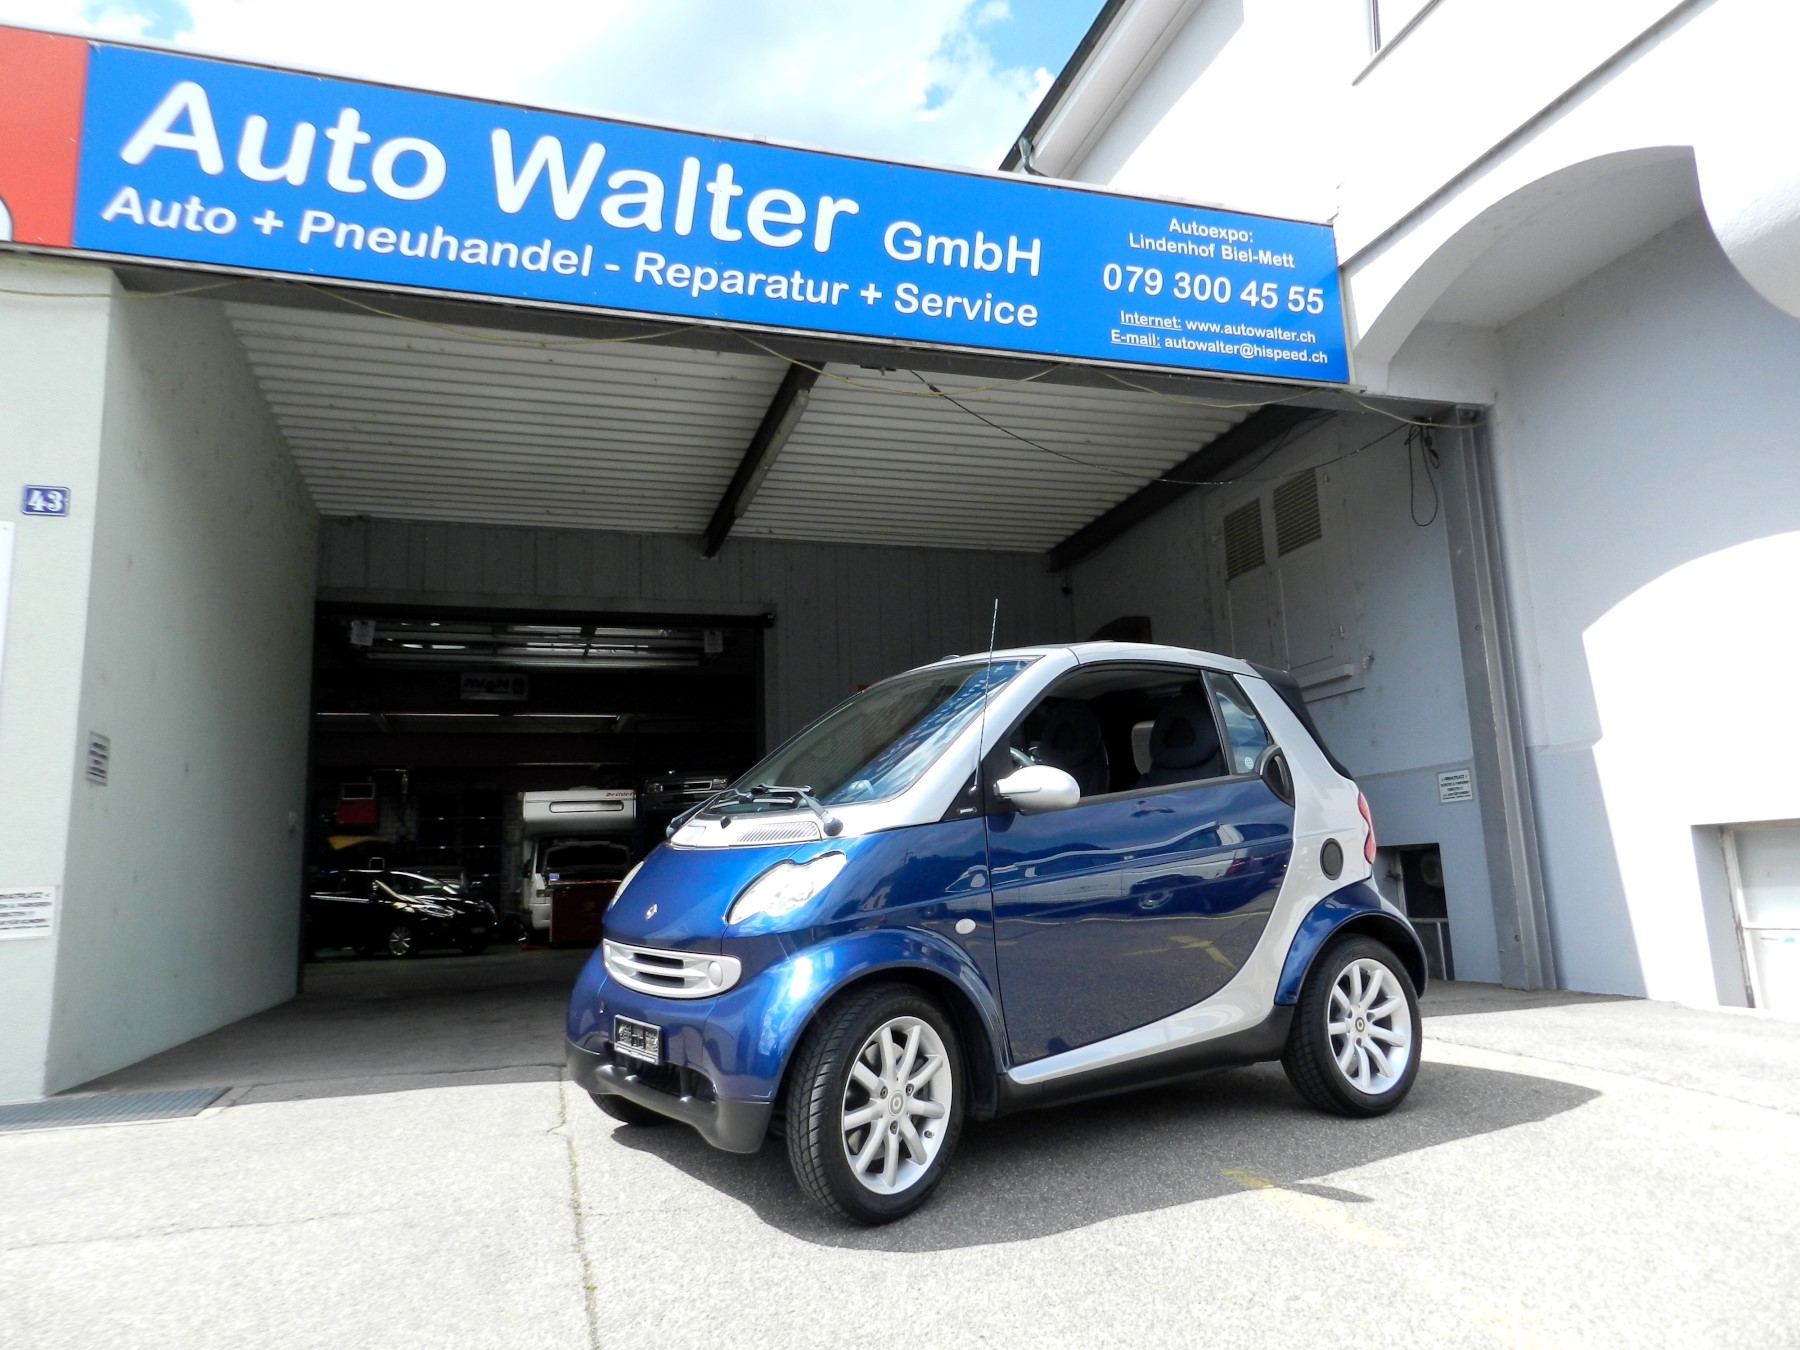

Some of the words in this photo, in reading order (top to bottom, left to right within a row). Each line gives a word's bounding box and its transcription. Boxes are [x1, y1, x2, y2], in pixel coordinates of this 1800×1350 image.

[119, 80, 447, 201] Auto
[490, 127, 860, 253] Walter
[883, 220, 1041, 277] GmbH
[1168, 217, 1254, 243] Autoexpo:
[100, 186, 237, 235] Auto
[252, 209, 284, 235] +
[298, 209, 593, 277] Pneuhandel
[604, 263, 620, 272] -
[634, 250, 850, 304] Reparatur
[860, 282, 883, 305] +
[894, 282, 1038, 327] Service
[1129, 232, 1216, 258] Lindenhof
[1220, 244, 1296, 269] Biel-Mett
[1102, 263, 1163, 296] 079
[1173, 271, 1232, 304] 300
[1239, 280, 1279, 310] 45
[1287, 285, 1324, 315] 55
[1120, 310, 1182, 331] Internet:
[1185, 320, 1316, 344] www.autowalter.ch
[1110, 329, 1162, 349] E-mail:
[1164, 337, 1328, 364] autowalter@hispeed.ch
[27, 489, 64, 512] 43
